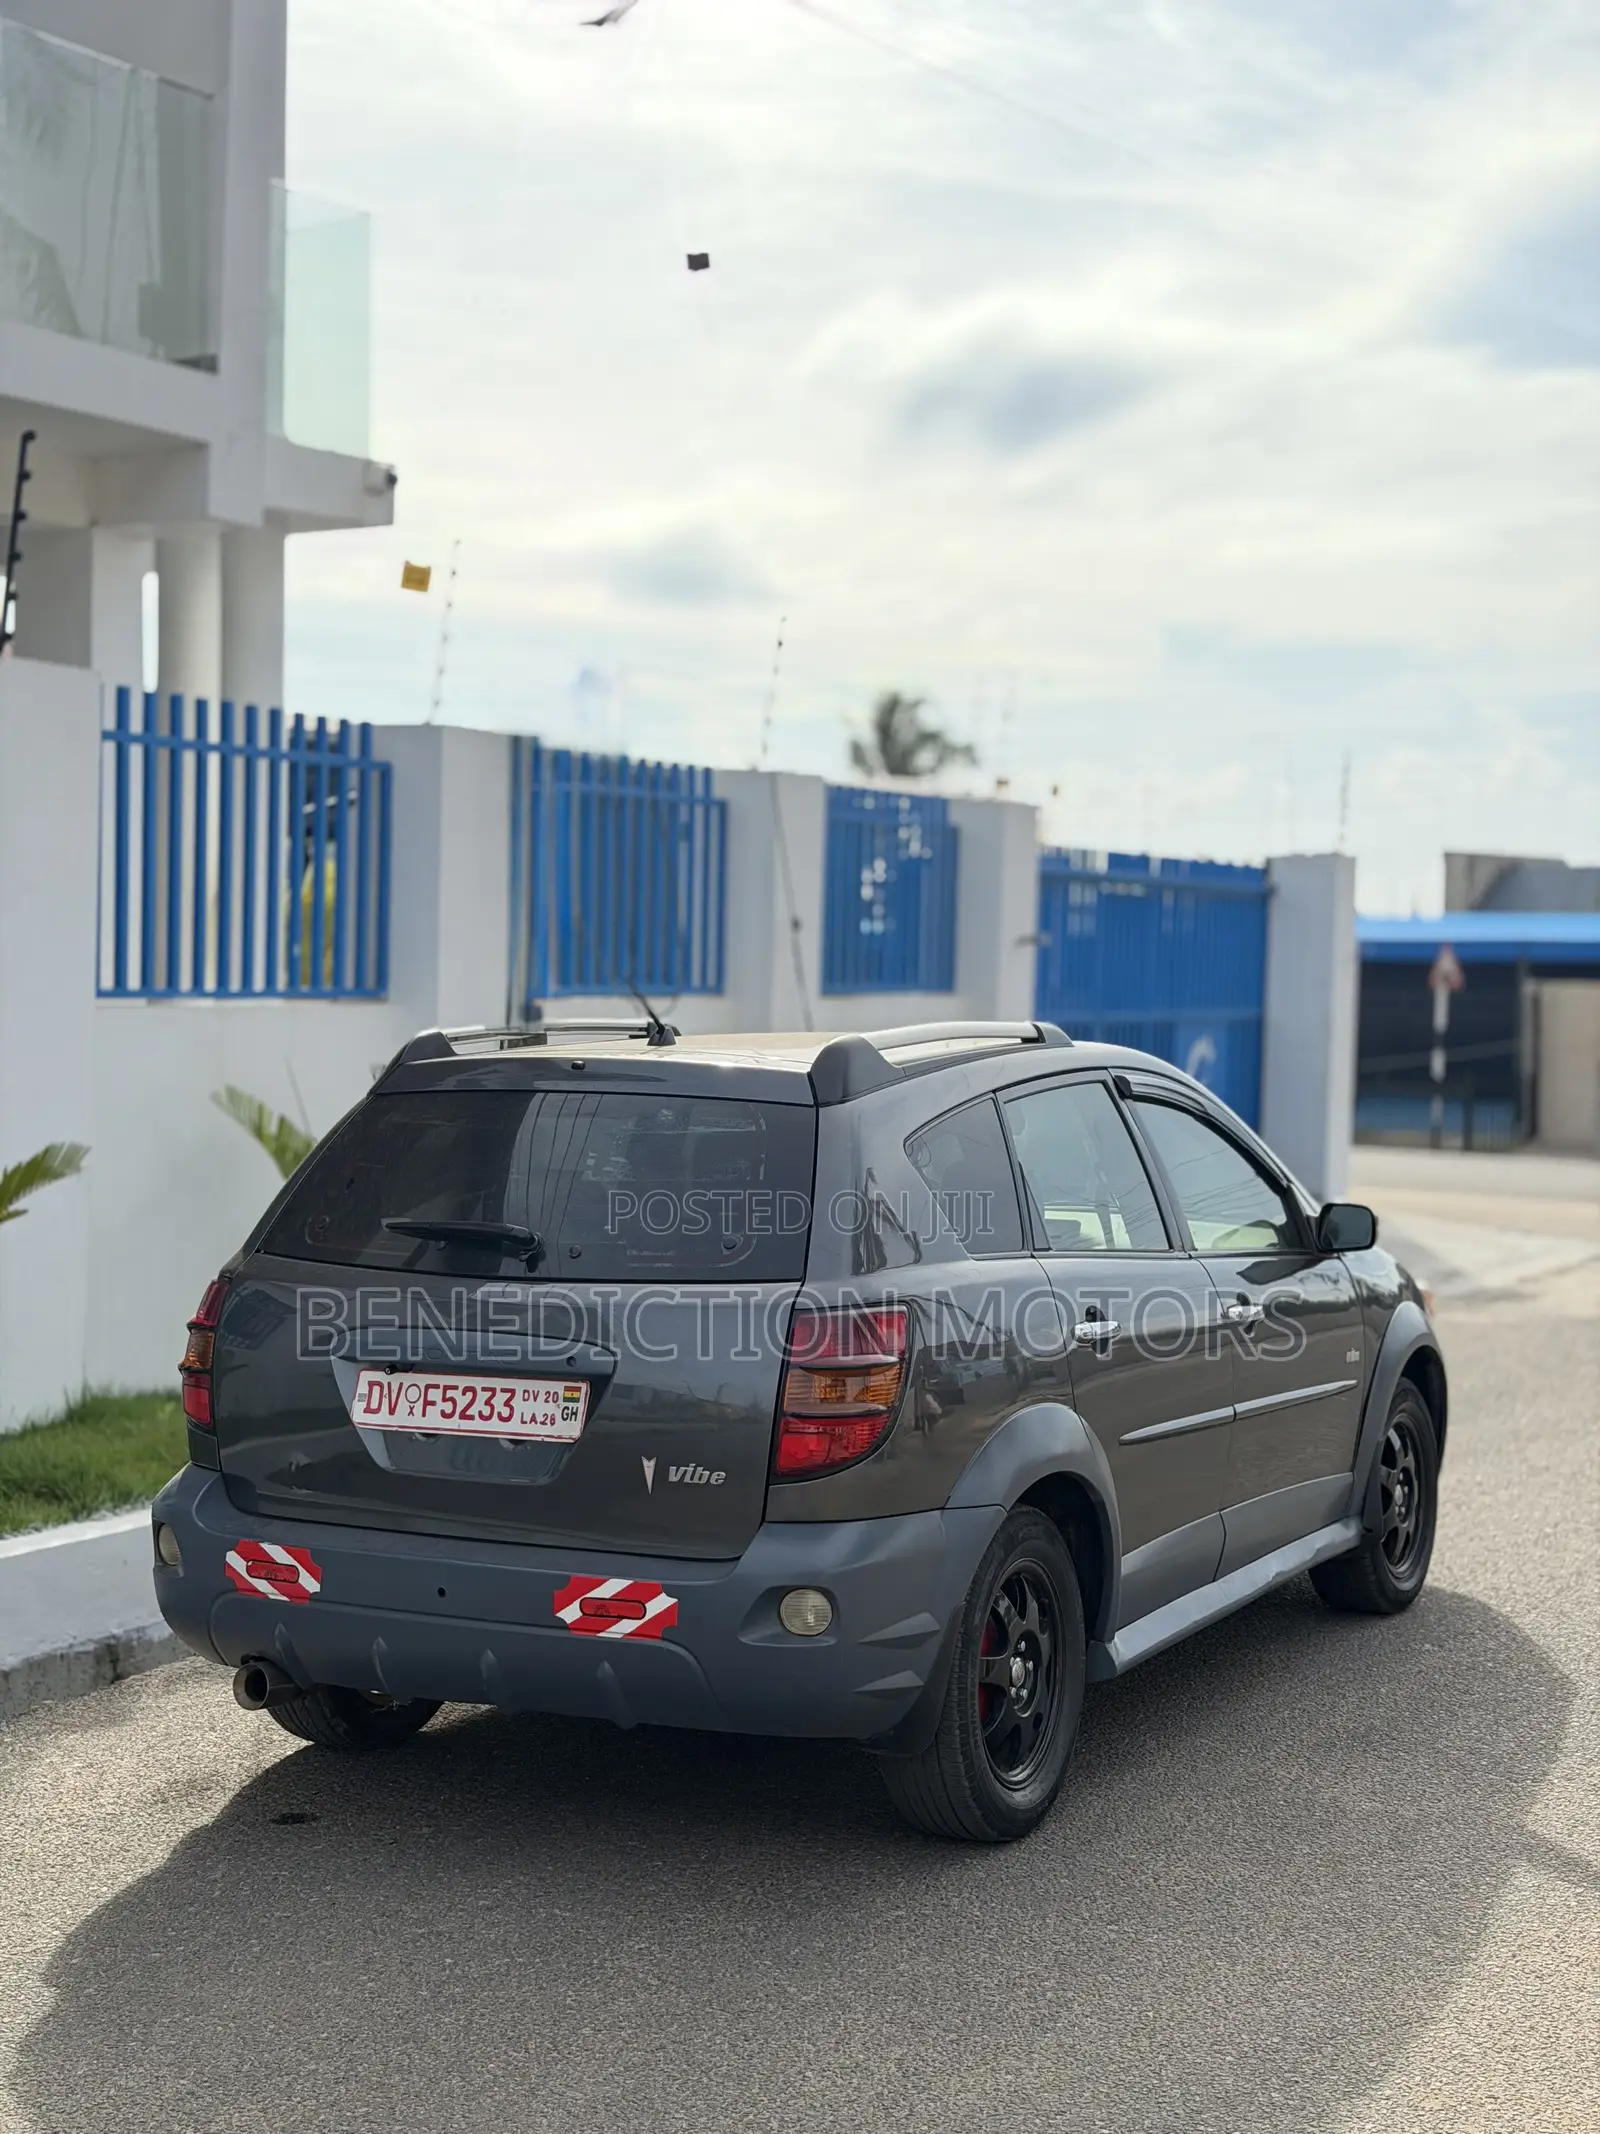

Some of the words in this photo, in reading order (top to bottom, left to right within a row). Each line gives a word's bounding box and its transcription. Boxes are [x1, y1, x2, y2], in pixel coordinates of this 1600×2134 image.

[522, 1389, 540, 1402] DV
[544, 1391, 559, 1404] 20
[561, 1406, 579, 1422] GH
